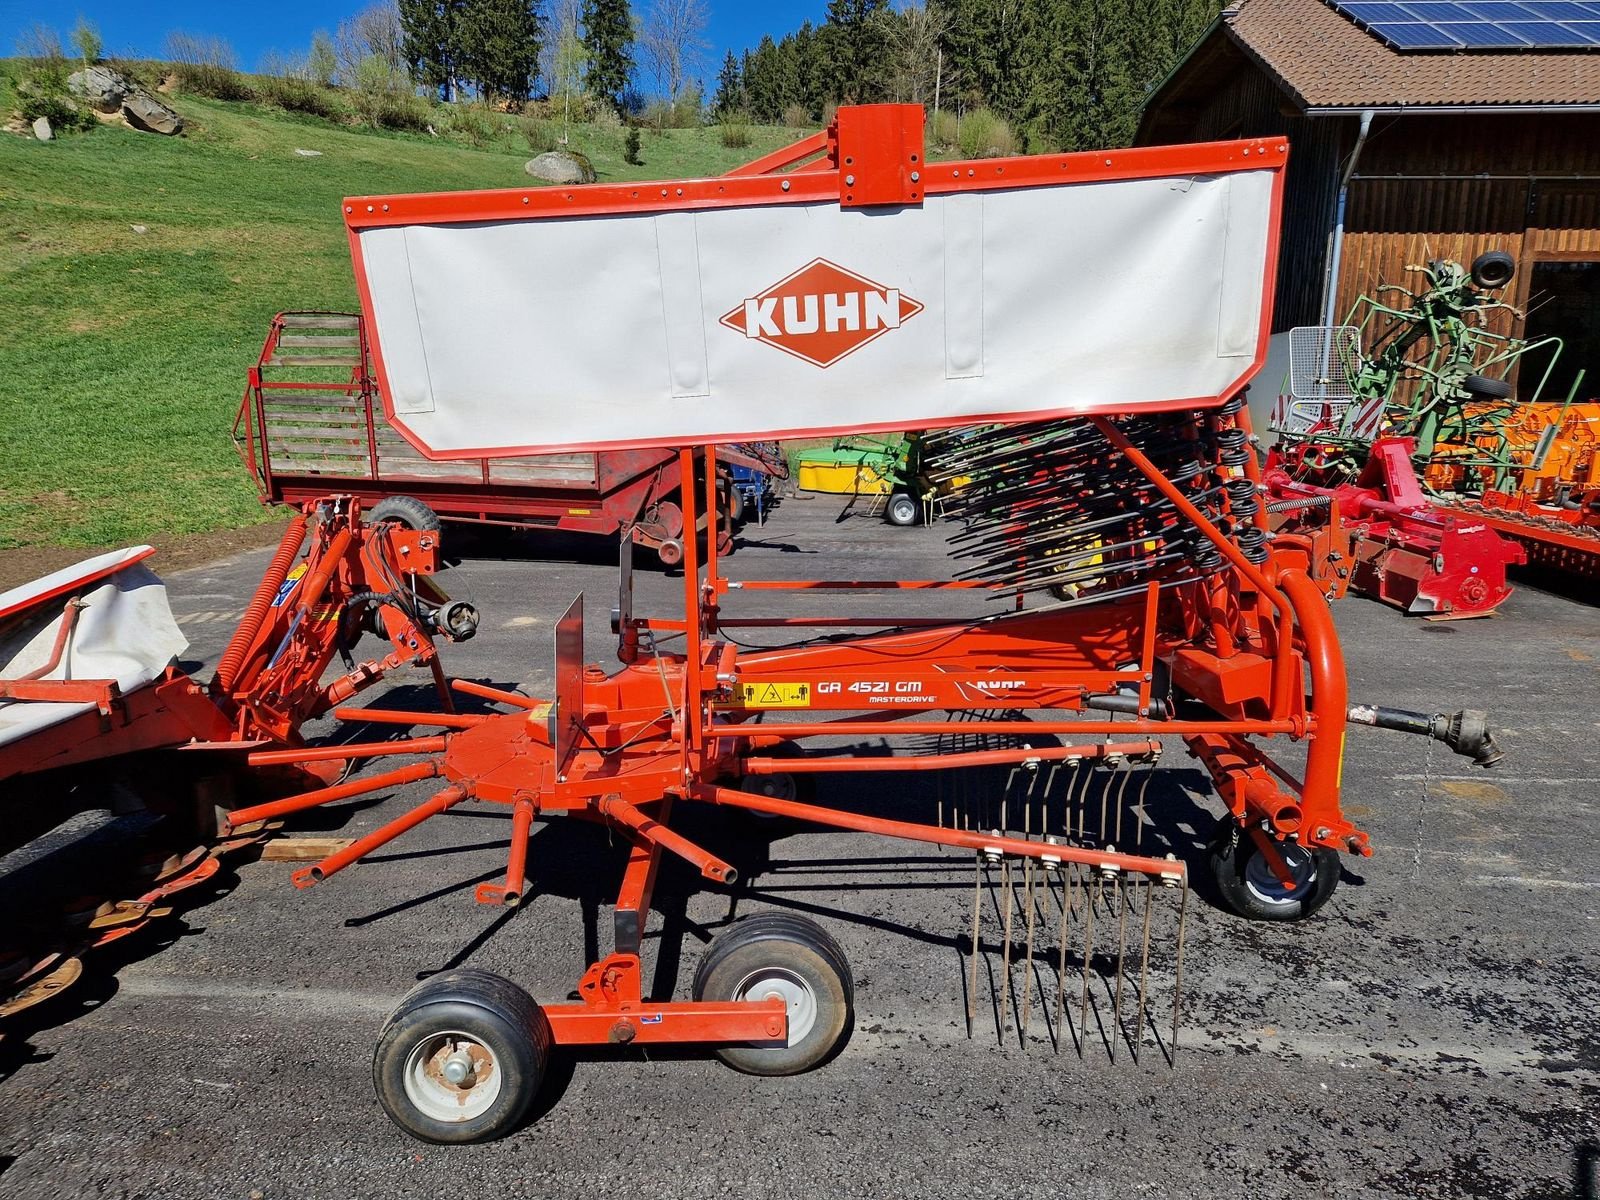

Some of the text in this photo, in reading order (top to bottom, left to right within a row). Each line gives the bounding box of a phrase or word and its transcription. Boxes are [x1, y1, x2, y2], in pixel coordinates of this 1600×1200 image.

[744, 288, 901, 338] KUHN
[817, 681, 922, 693] GA 4521 GM
